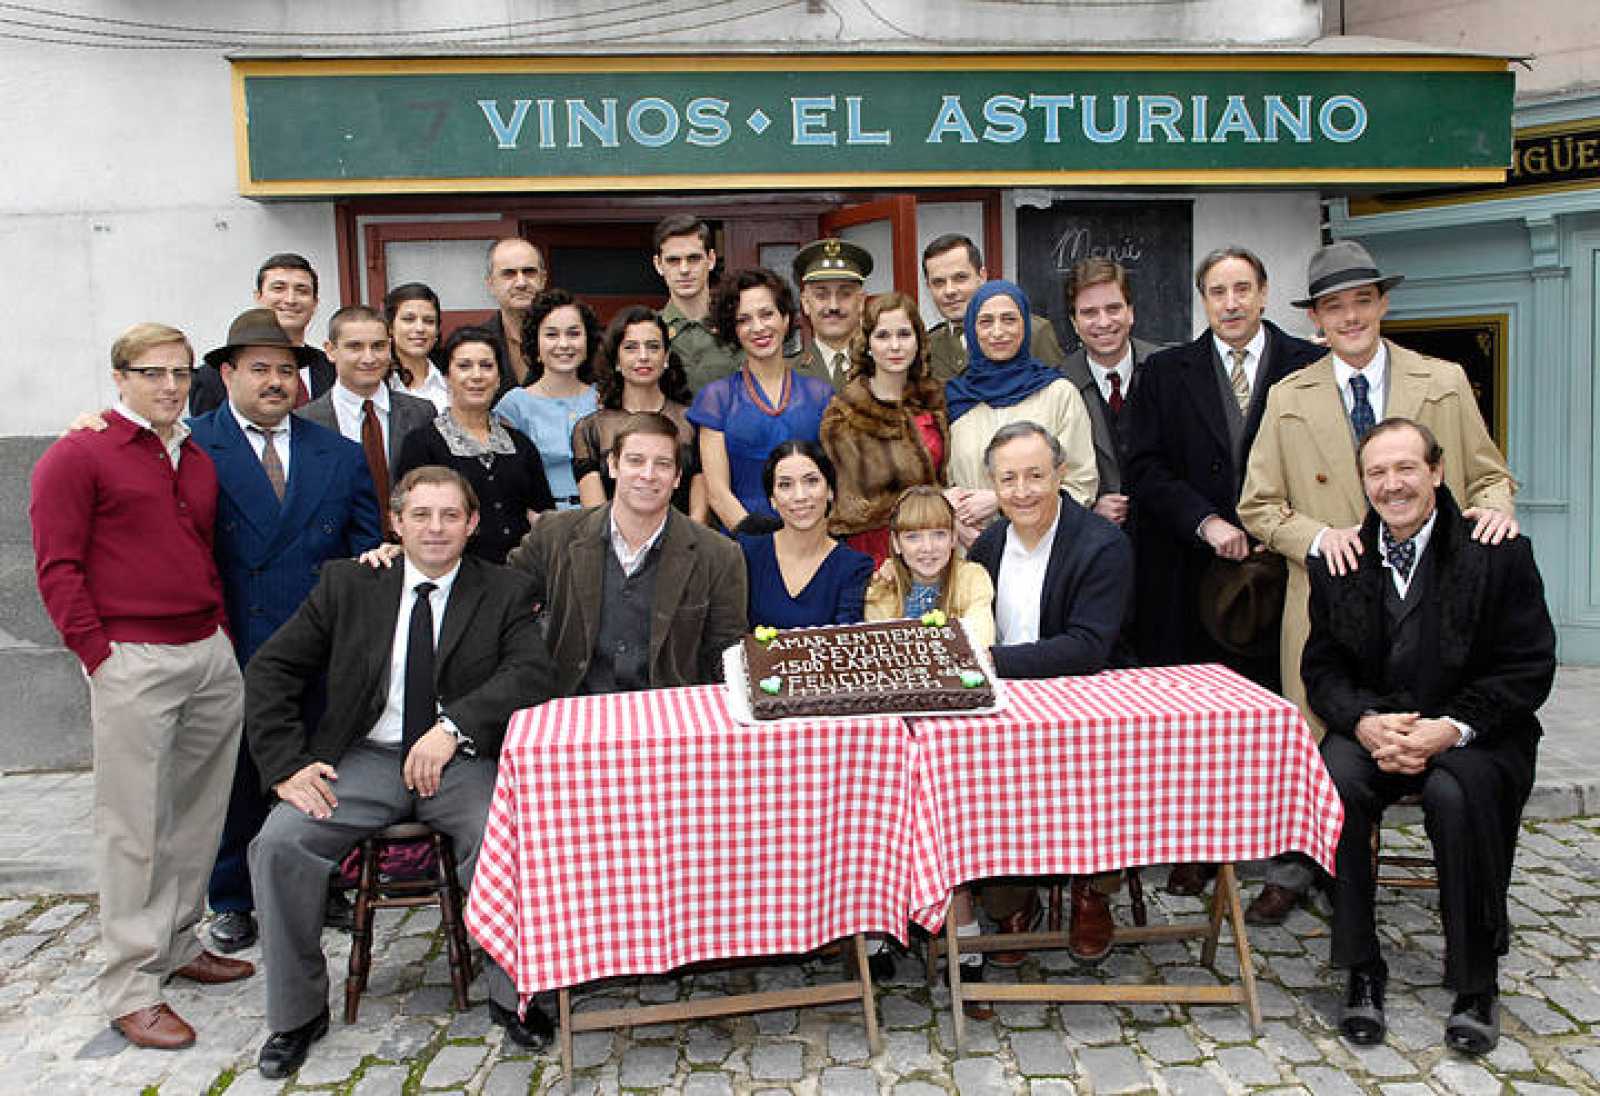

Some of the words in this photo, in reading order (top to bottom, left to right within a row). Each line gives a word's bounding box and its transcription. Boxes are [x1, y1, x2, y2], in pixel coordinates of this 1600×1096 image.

[478, 97, 732, 150] VINOS
[791, 95, 891, 147] EL
[926, 93, 1369, 144] ASTURIANO
[767, 634, 832, 652] AMAR
[809, 640, 947, 661] REVUELTOS
[770, 659, 825, 675] 1500
